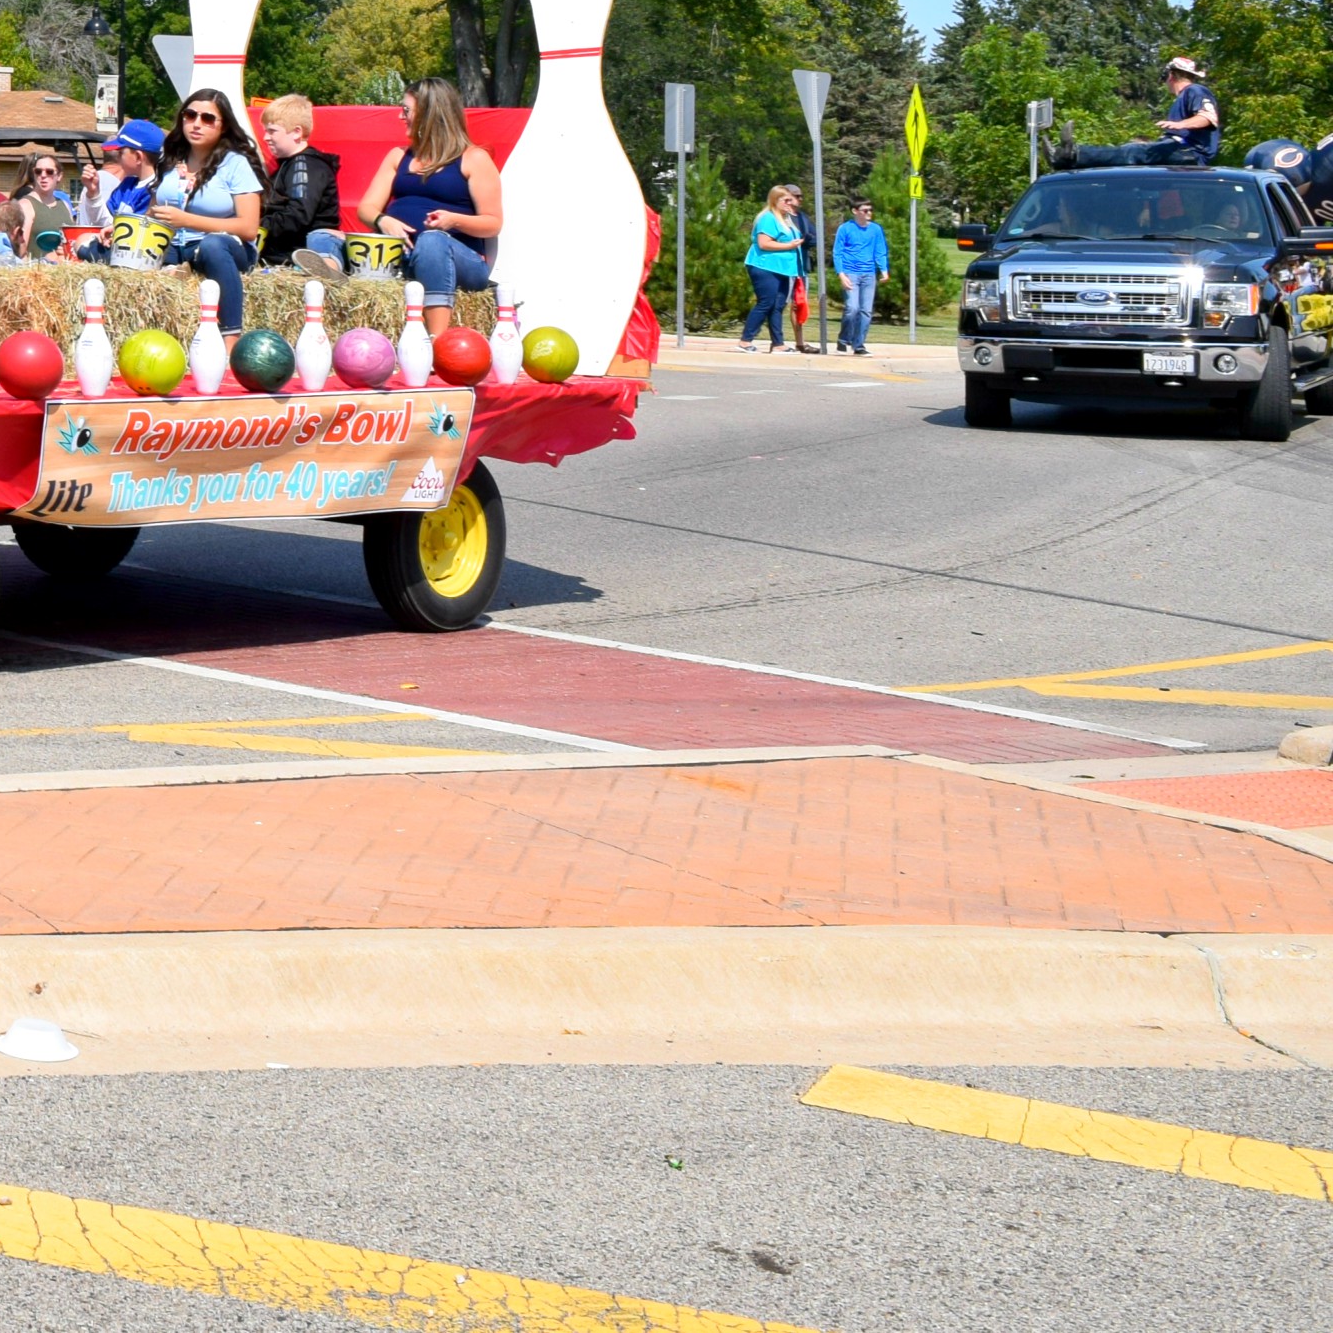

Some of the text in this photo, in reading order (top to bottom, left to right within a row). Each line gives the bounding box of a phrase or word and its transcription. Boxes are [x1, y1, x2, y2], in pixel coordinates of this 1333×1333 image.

[349, 241, 403, 271] 312
[1145, 359, 1188, 371] 1231948
[111, 399, 414, 462] Raymond's Bowl
[106, 460, 398, 513] Thanks you for 40 years!
[411, 470, 445, 489] Coors
[414, 490, 438, 499] LIGHT
[26, 479, 93, 517] Lite
